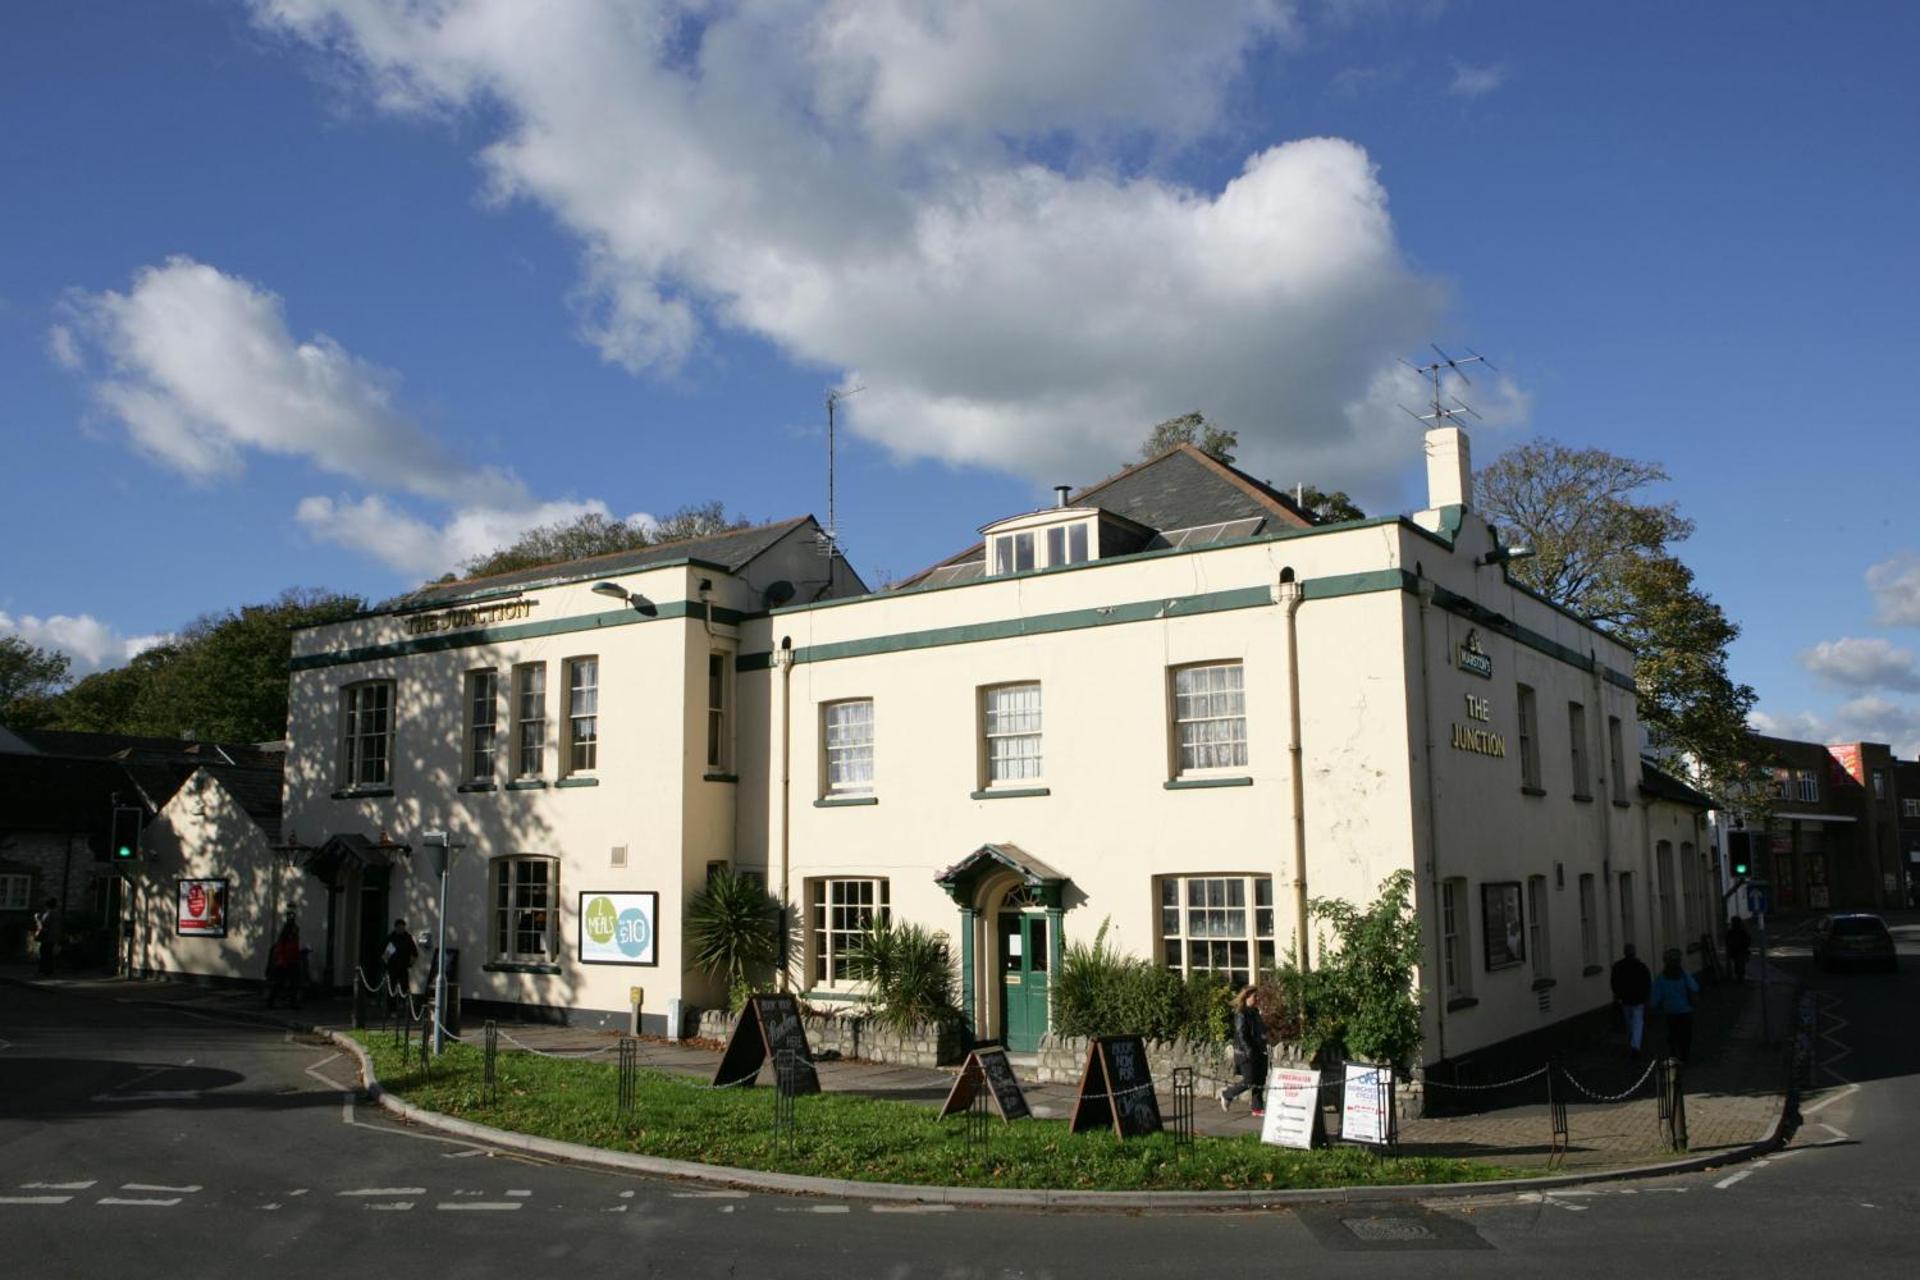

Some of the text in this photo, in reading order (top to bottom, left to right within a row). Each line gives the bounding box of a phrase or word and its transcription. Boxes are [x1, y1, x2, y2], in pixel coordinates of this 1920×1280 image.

[407, 600, 530, 635] THE JUNCTION
[1465, 693, 1489, 721] THE
[1452, 722, 1505, 757] JUNCTION
[588, 915, 614, 936] MEALS
[620, 918, 646, 944] £10
